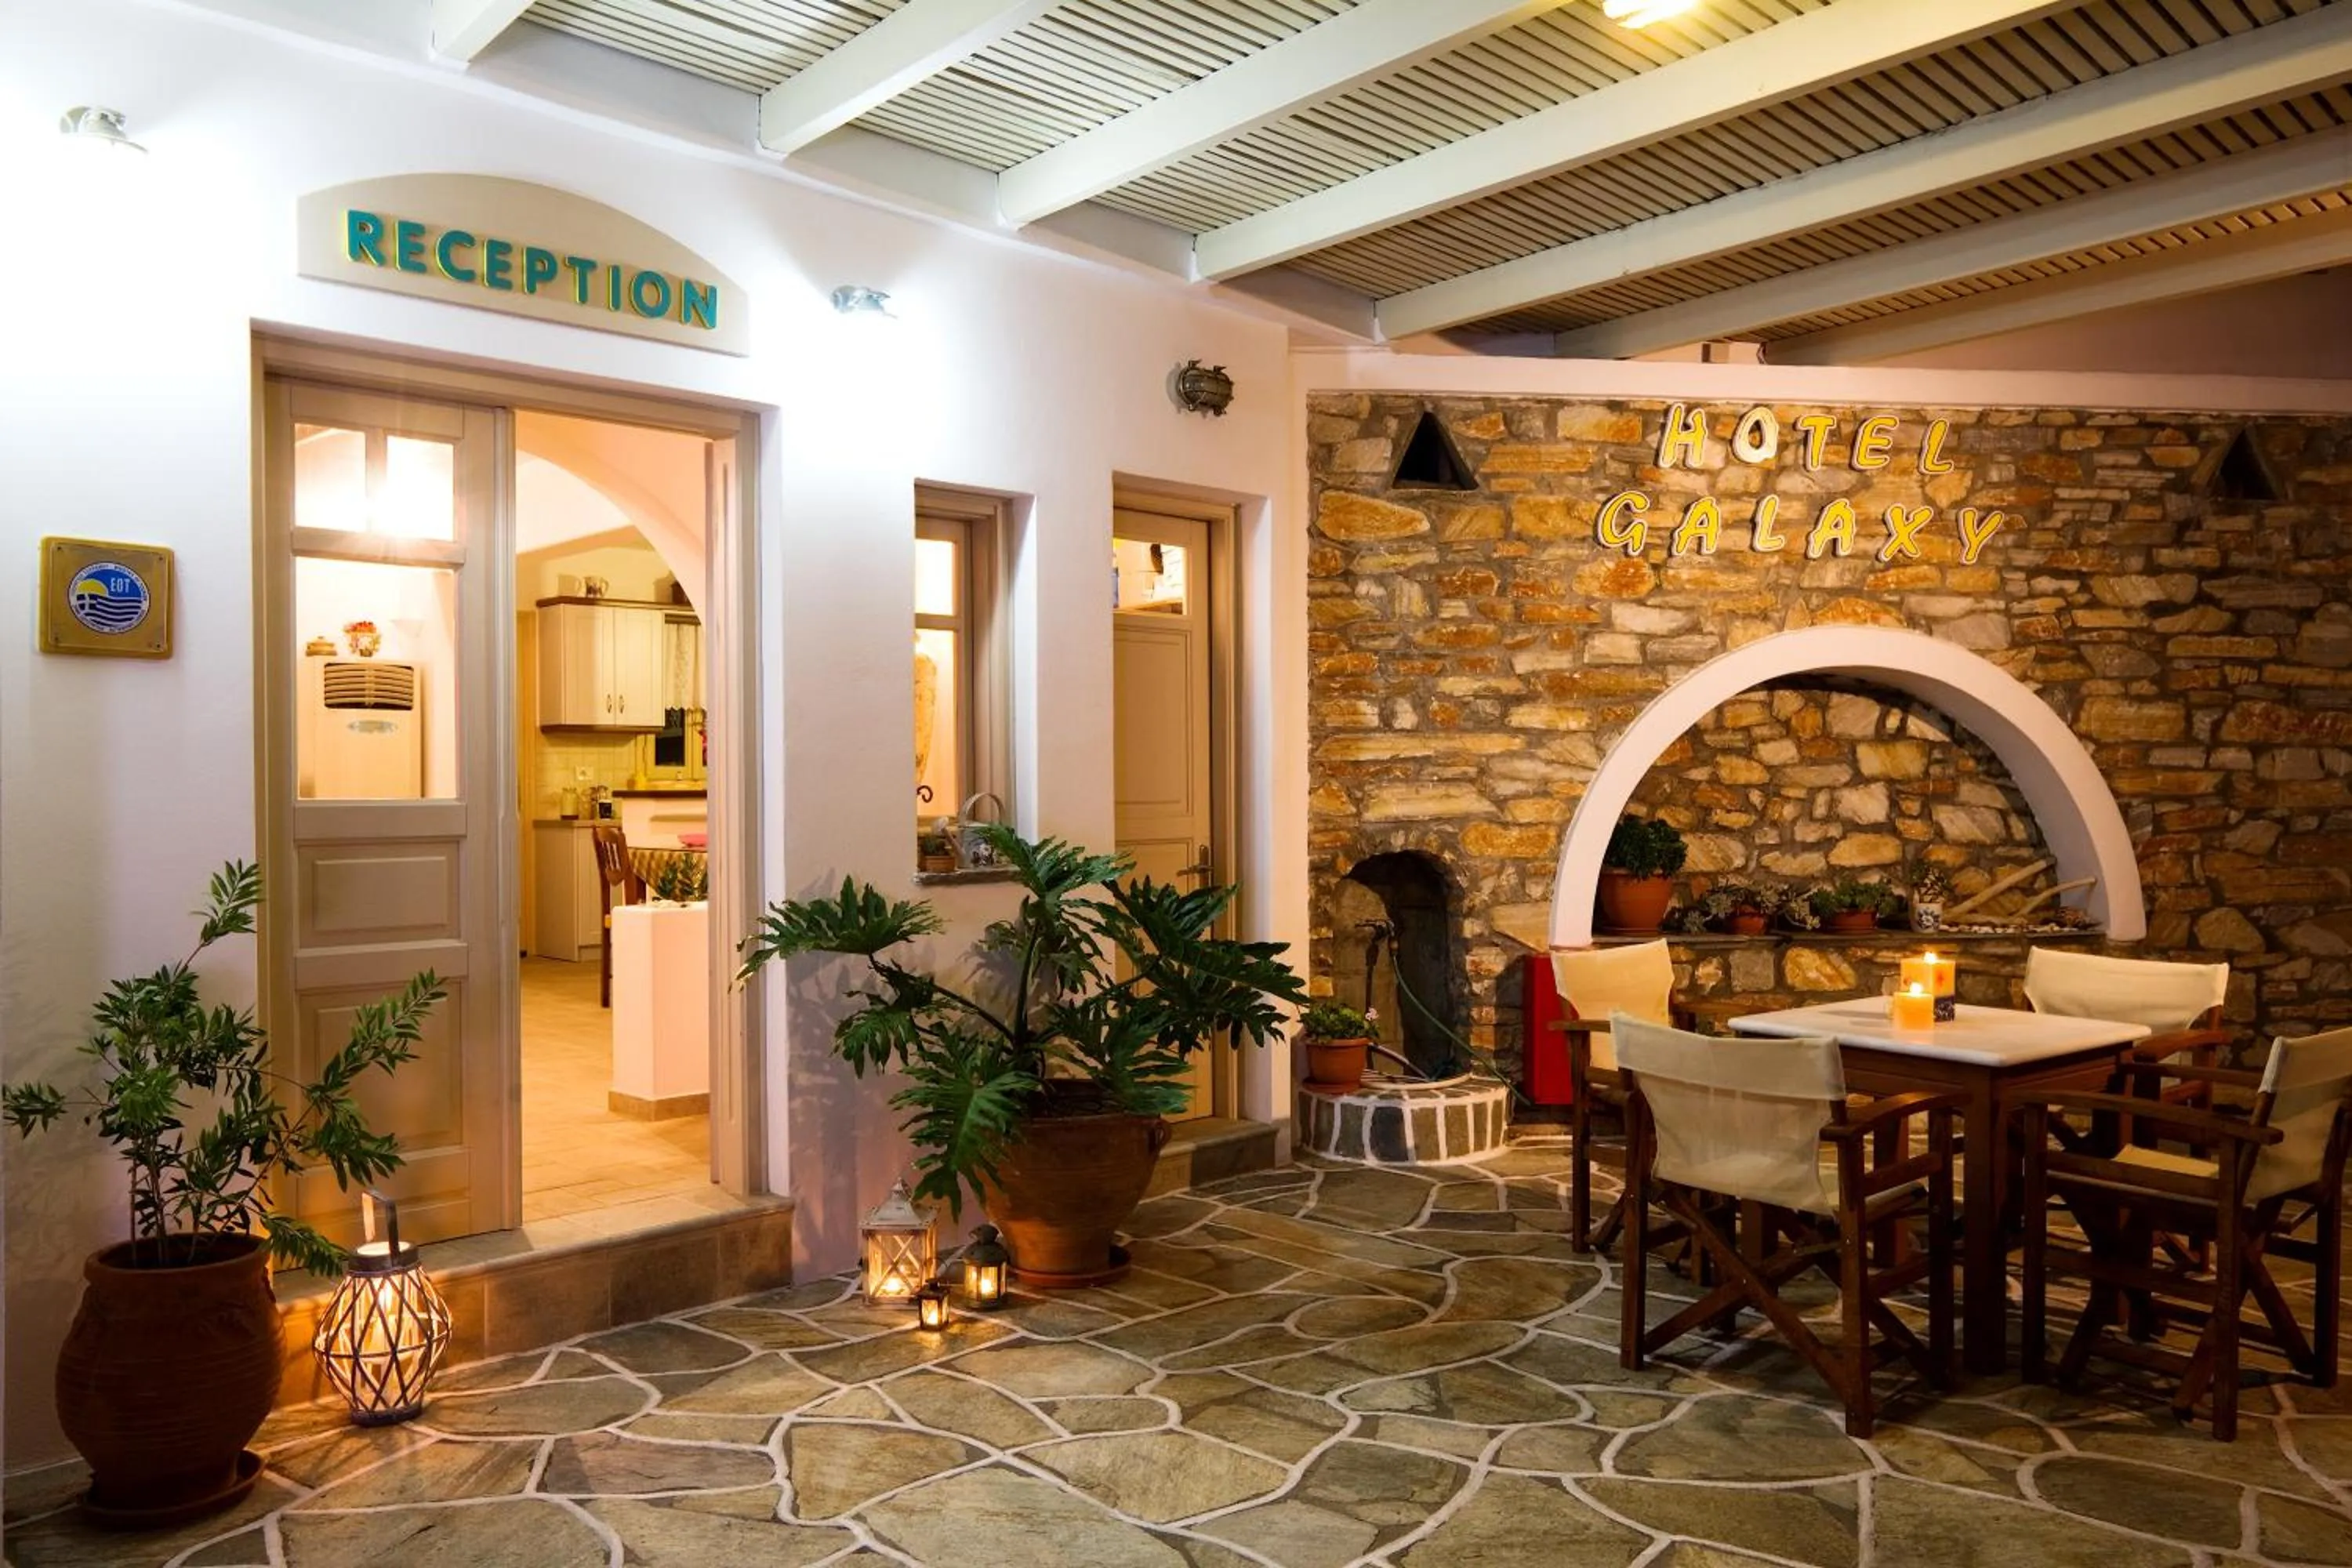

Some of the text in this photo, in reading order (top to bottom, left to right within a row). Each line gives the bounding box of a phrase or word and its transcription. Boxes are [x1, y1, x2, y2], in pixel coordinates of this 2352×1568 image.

[344, 209, 717, 329] RECEPTION
[1658, 403, 1955, 474] HOTEL
[1596, 491, 2005, 564] GALAXY
[111, 578, 131, 593] EOT
